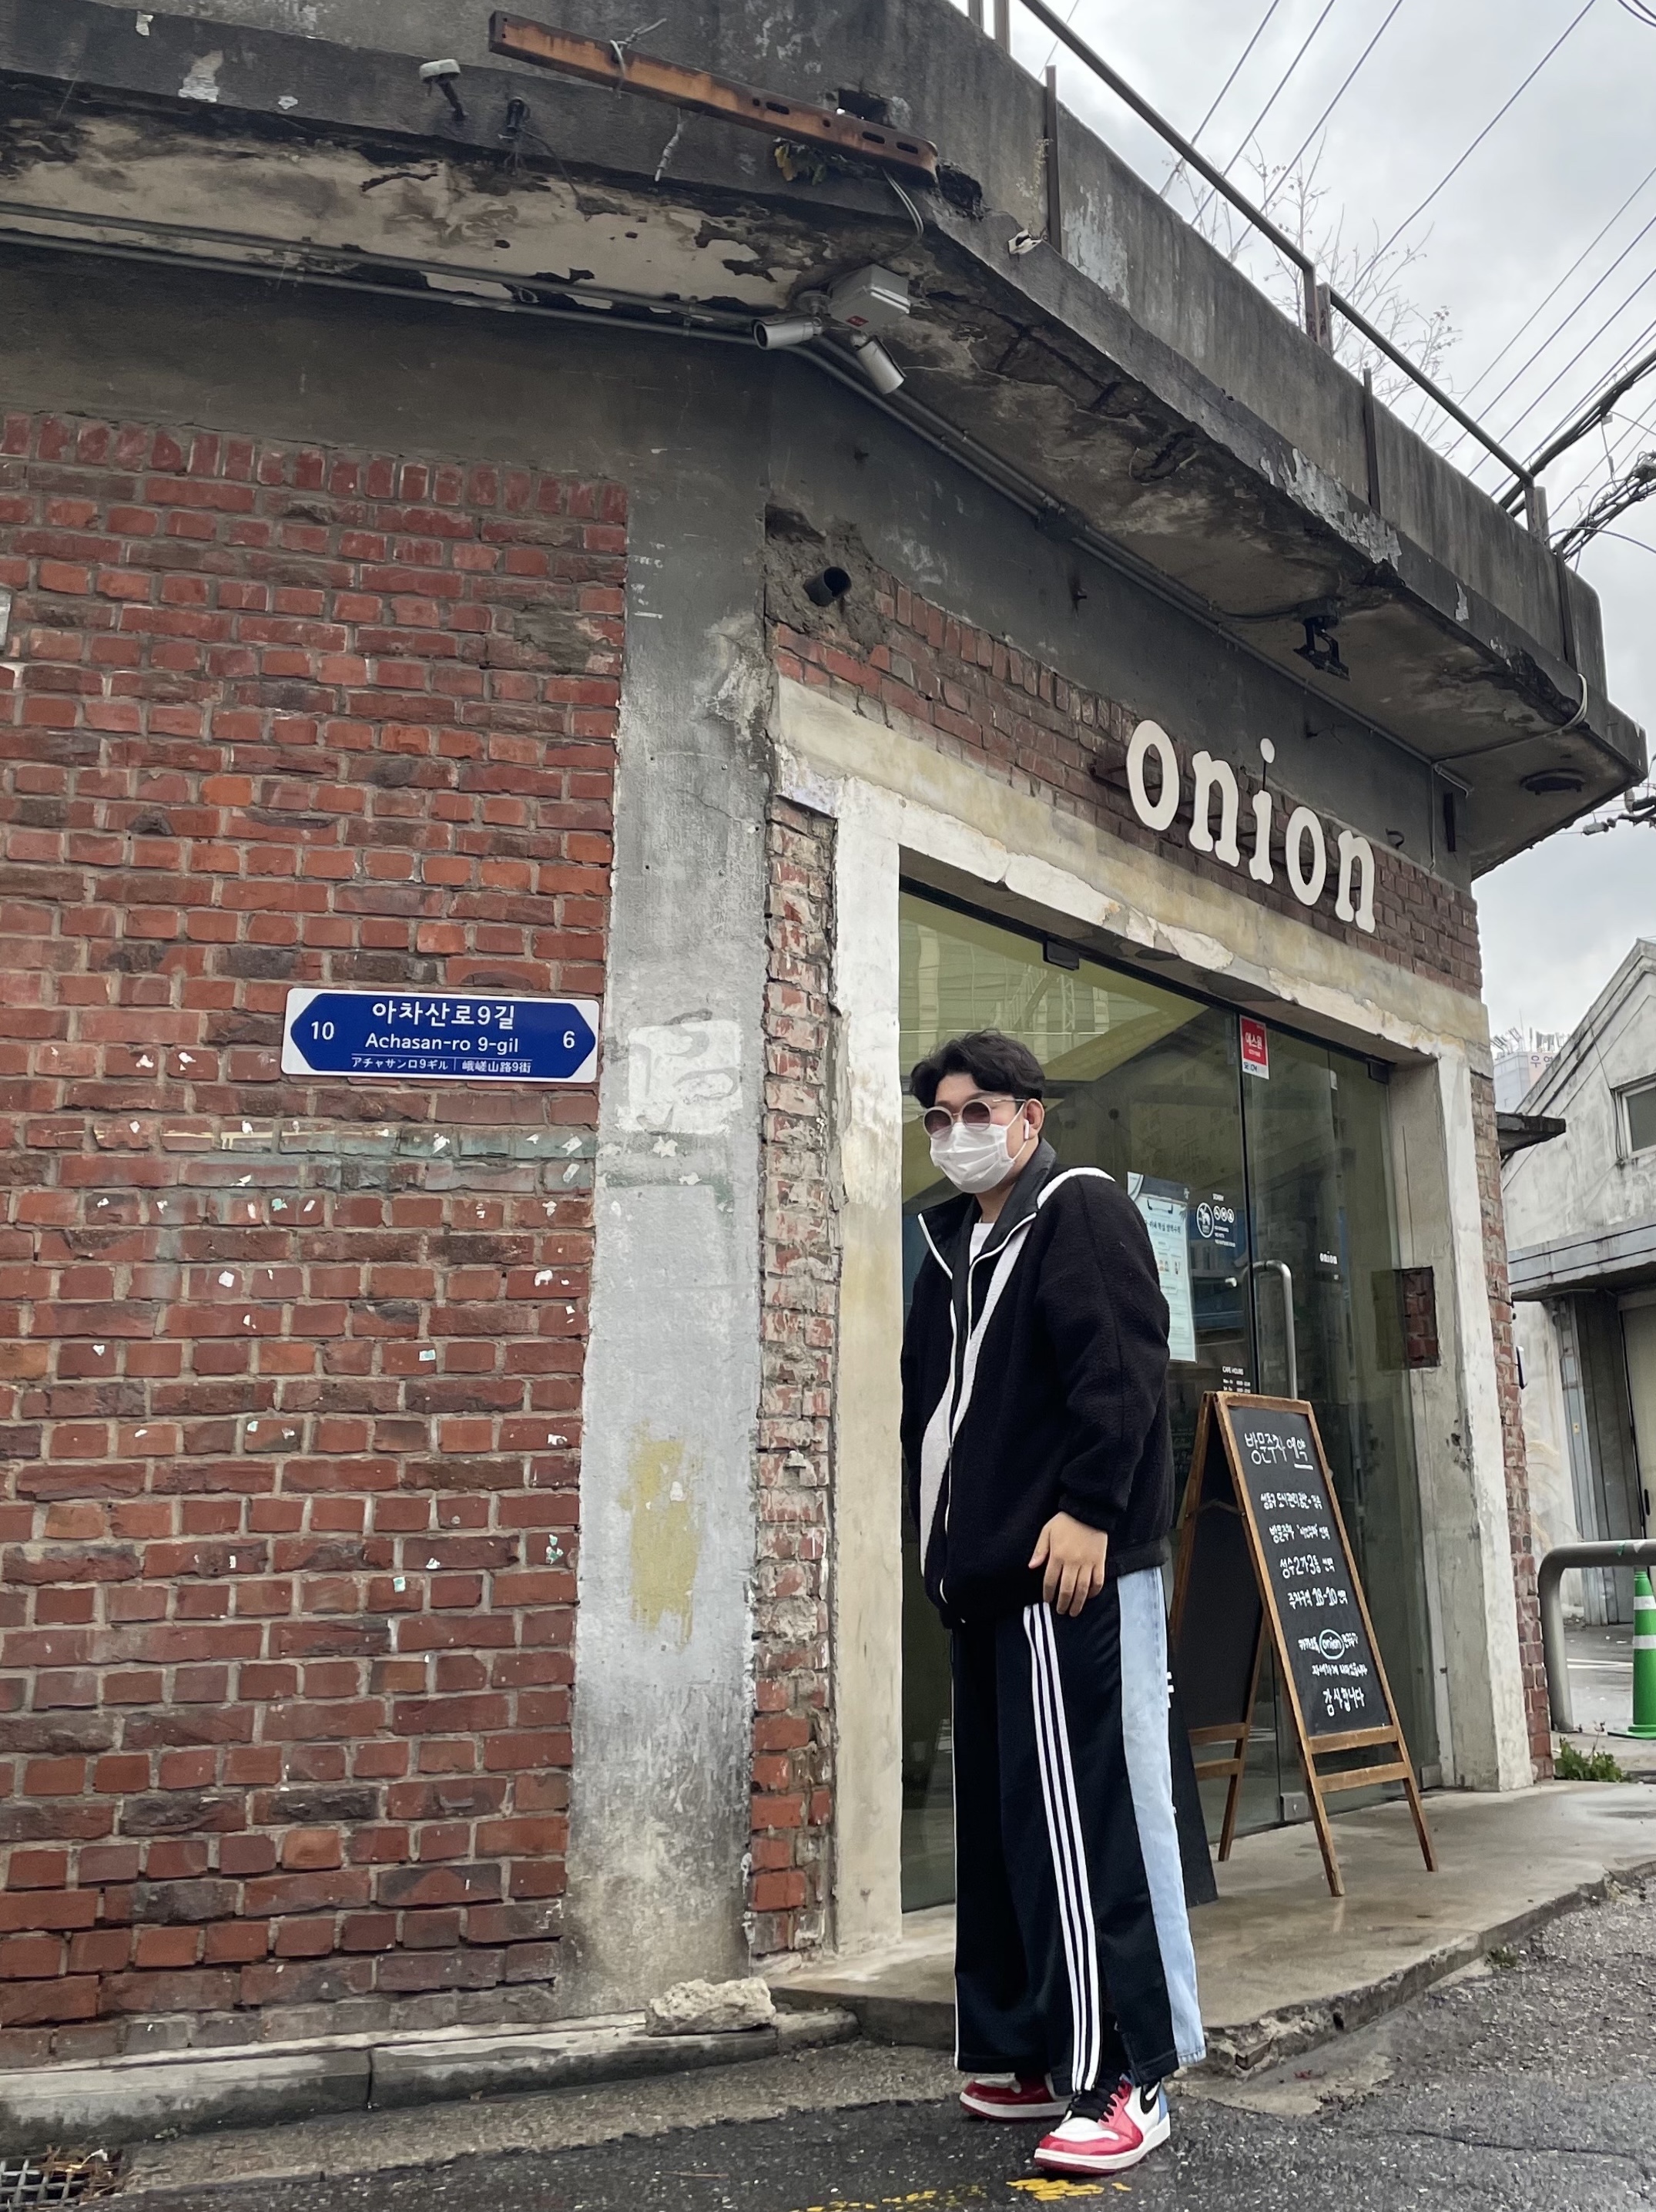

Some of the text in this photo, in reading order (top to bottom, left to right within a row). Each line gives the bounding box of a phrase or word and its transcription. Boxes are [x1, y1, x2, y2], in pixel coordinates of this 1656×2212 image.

[1126, 720, 1376, 933] onion
[372, 1000, 515, 1030] 아차산로9길
[311, 1021, 334, 1041] 10
[364, 1032, 518, 1054] Achasan-ro 9-gil
[562, 1030, 575, 1049] 6
[1244, 1432, 1287, 1465] 방문주차
[1322, 1636, 1342, 1650] onion
[1322, 1686, 1365, 1717] 감사합니다
